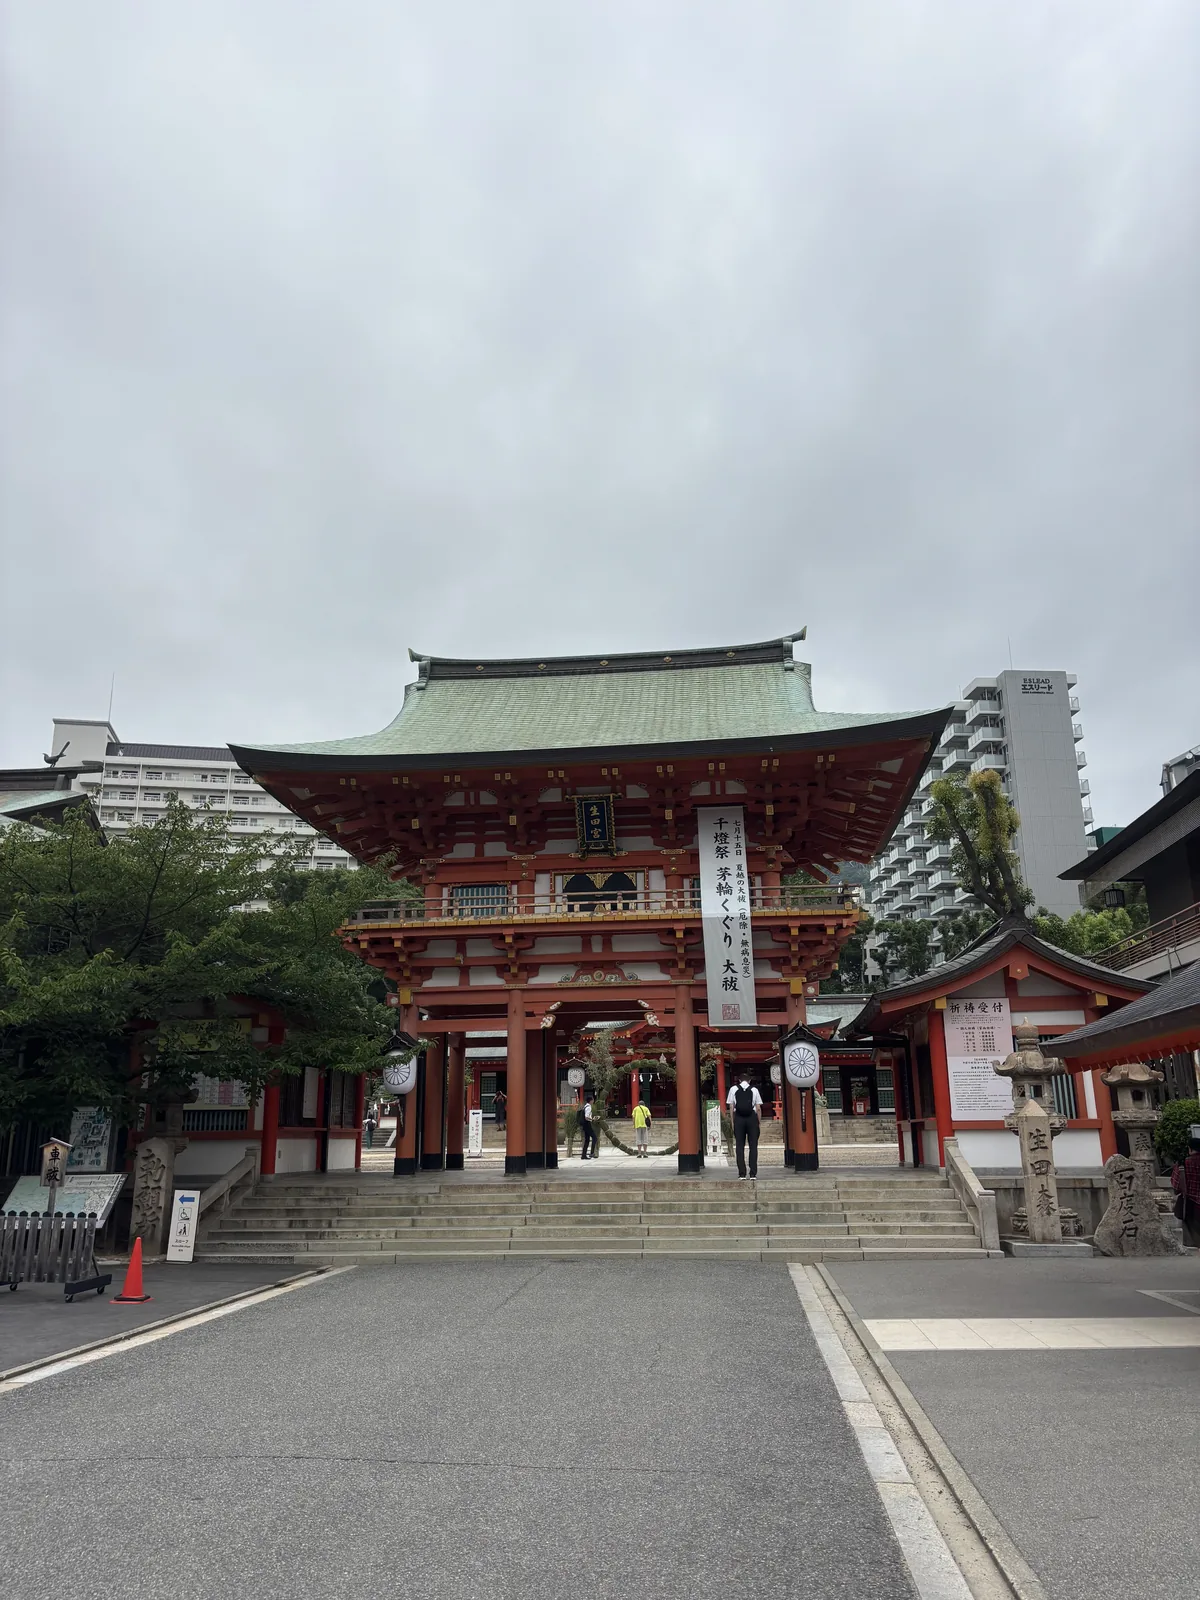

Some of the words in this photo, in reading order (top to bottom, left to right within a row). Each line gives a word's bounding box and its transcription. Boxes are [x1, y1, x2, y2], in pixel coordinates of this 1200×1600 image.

[713, 817, 731, 859] 千燈祭
[733, 820, 743, 856] 七月十五日
[716, 867, 735, 948] 茅輪くぐり
[722, 959, 740, 992] 大祓
[949, 1001, 1003, 1013] 祈祷受付
[46, 1146, 60, 1182] 車祓
[1114, 1167, 1139, 1240] 百度石
